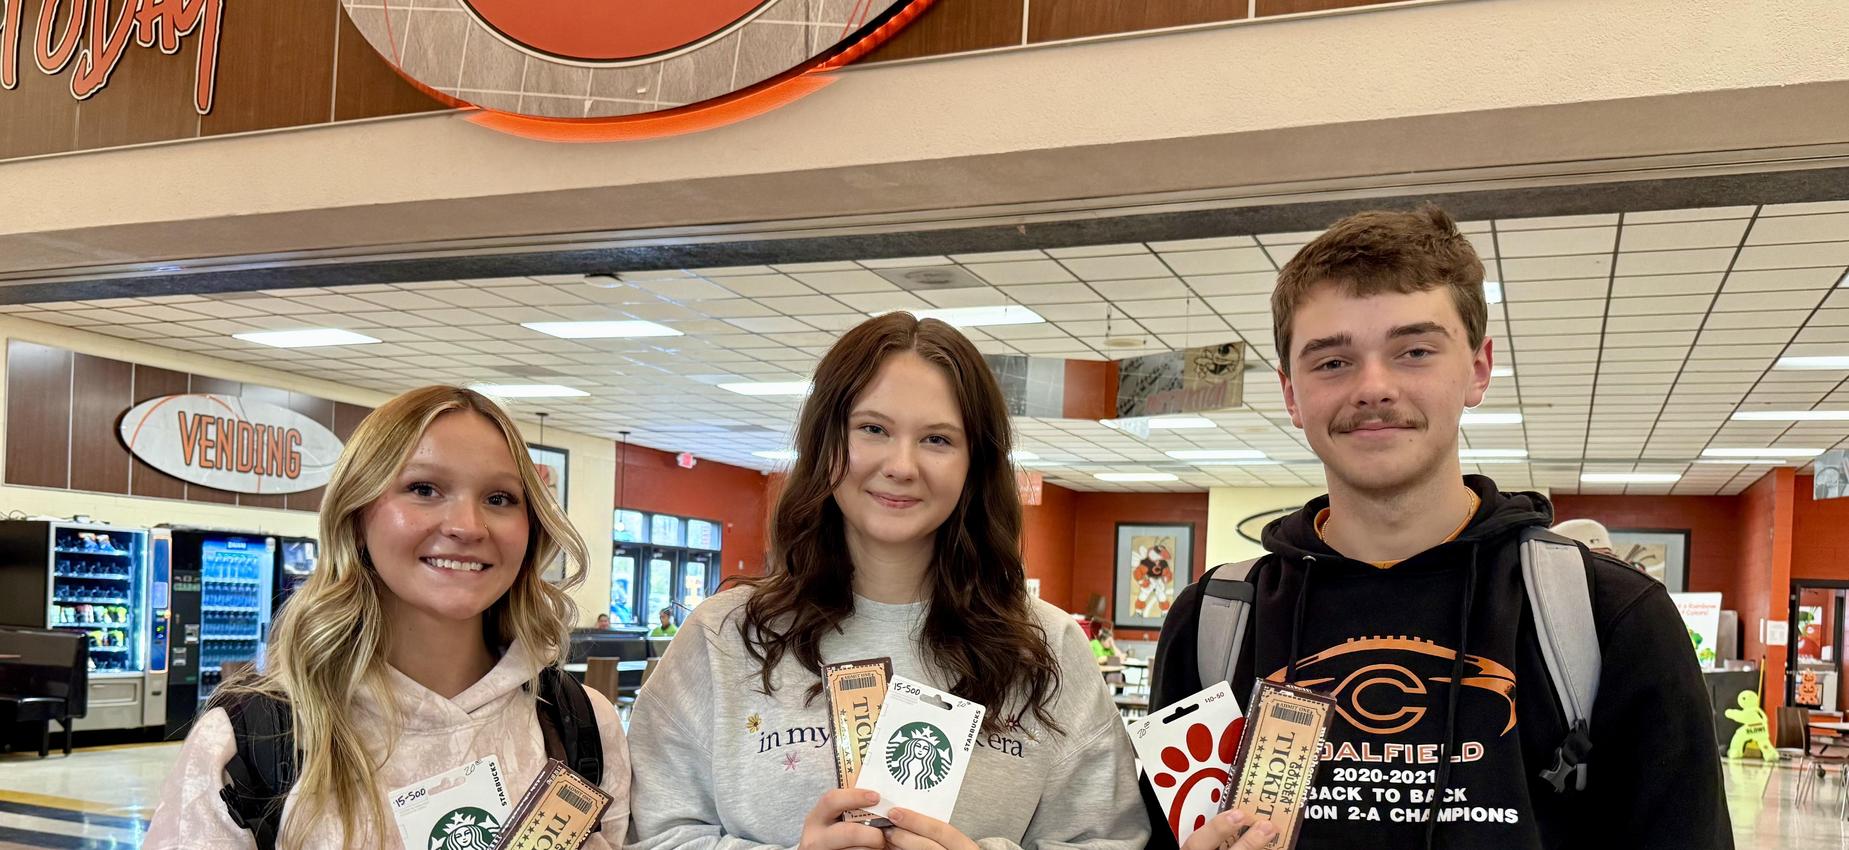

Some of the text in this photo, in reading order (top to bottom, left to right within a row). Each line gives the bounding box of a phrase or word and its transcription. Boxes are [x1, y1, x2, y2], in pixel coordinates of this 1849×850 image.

[178, 410, 302, 479] VENDING
[893, 682, 921, 696] 15-500
[757, 731, 782, 754] in
[786, 726, 830, 748] my
[987, 732, 1025, 759] era
[852, 696, 872, 764] TICK
[963, 709, 981, 752] STARBUCKS
[488, 761, 508, 807] STARBUCKS
[1255, 731, 1296, 821] TICKET
[1280, 761, 1299, 804] GOLDEN
[1333, 768, 1436, 785] 2020-2021
[1372, 787, 1401, 803] TO
[534, 812, 571, 850] TIC
[1347, 806, 1381, 822] 2-A
[1389, 806, 1519, 824] CHAMPIONS
